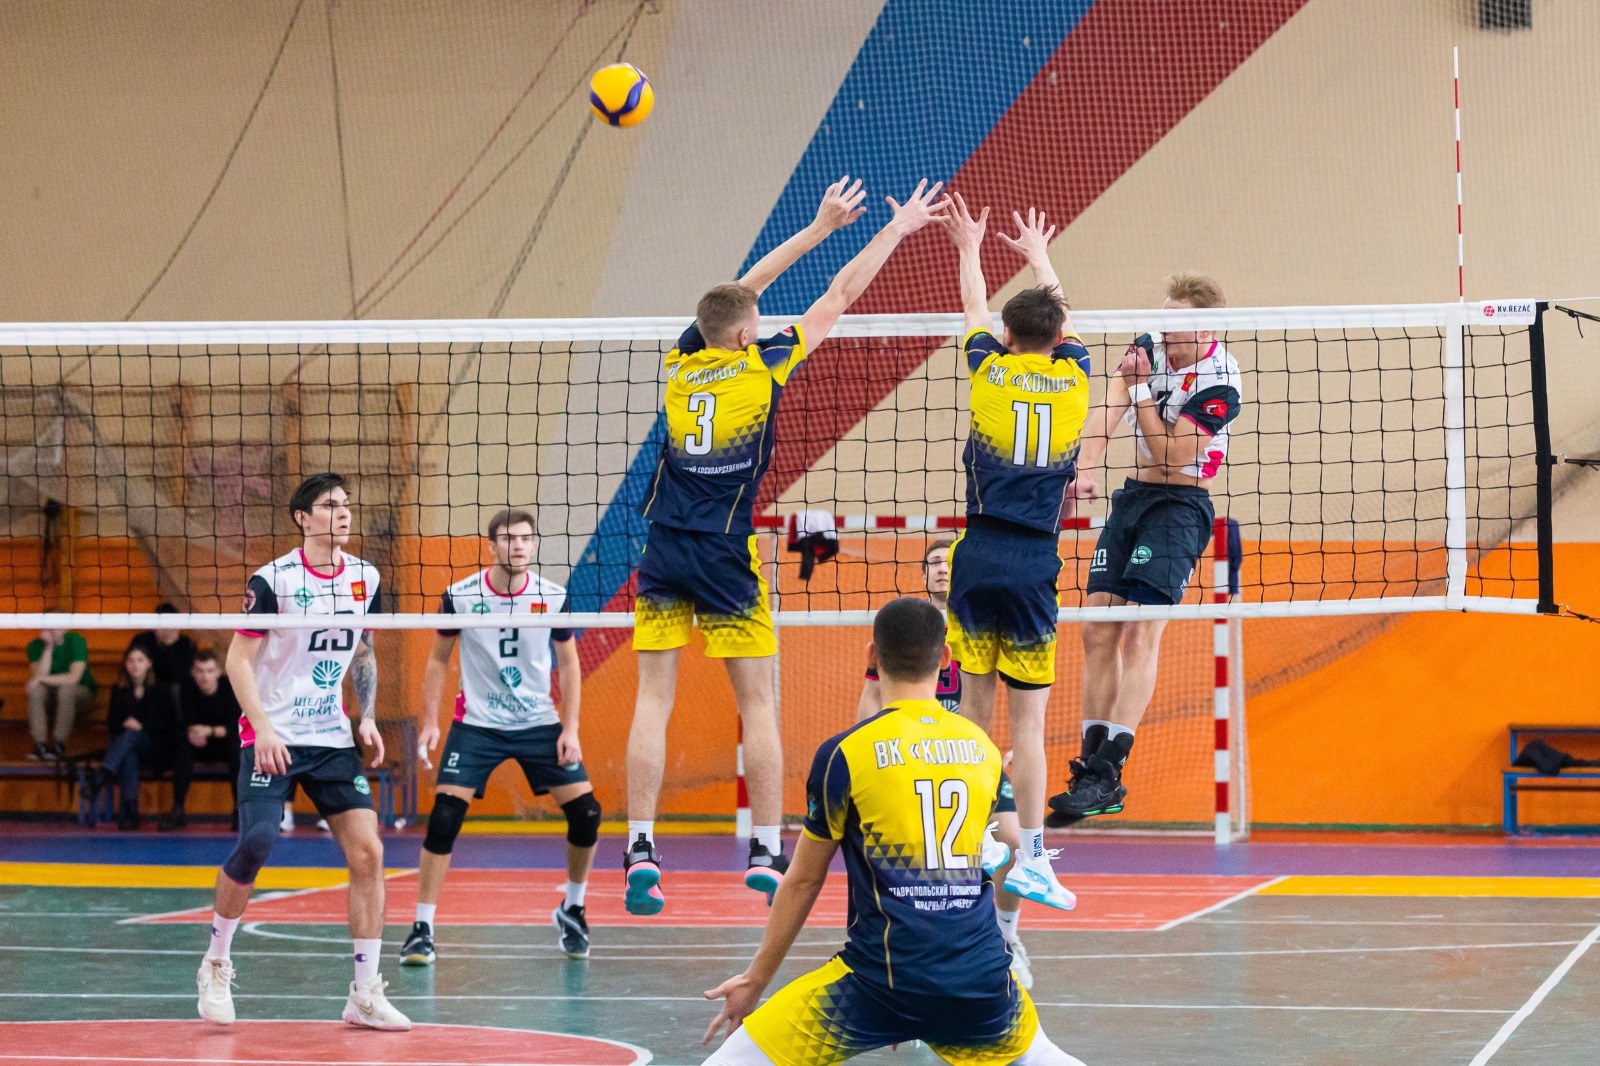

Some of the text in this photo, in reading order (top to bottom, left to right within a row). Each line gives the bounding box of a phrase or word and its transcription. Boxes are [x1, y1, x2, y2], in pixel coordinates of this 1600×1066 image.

[987, 364, 1009, 387] ВК
[684, 391, 717, 456] 3
[1011, 400, 1052, 468] 11
[1091, 549, 1107, 567] 10
[500, 628, 518, 658] 2
[447, 751, 460, 767] 2
[873, 738, 987, 769] ВК «КОЛОС»
[914, 779, 969, 870] 12
